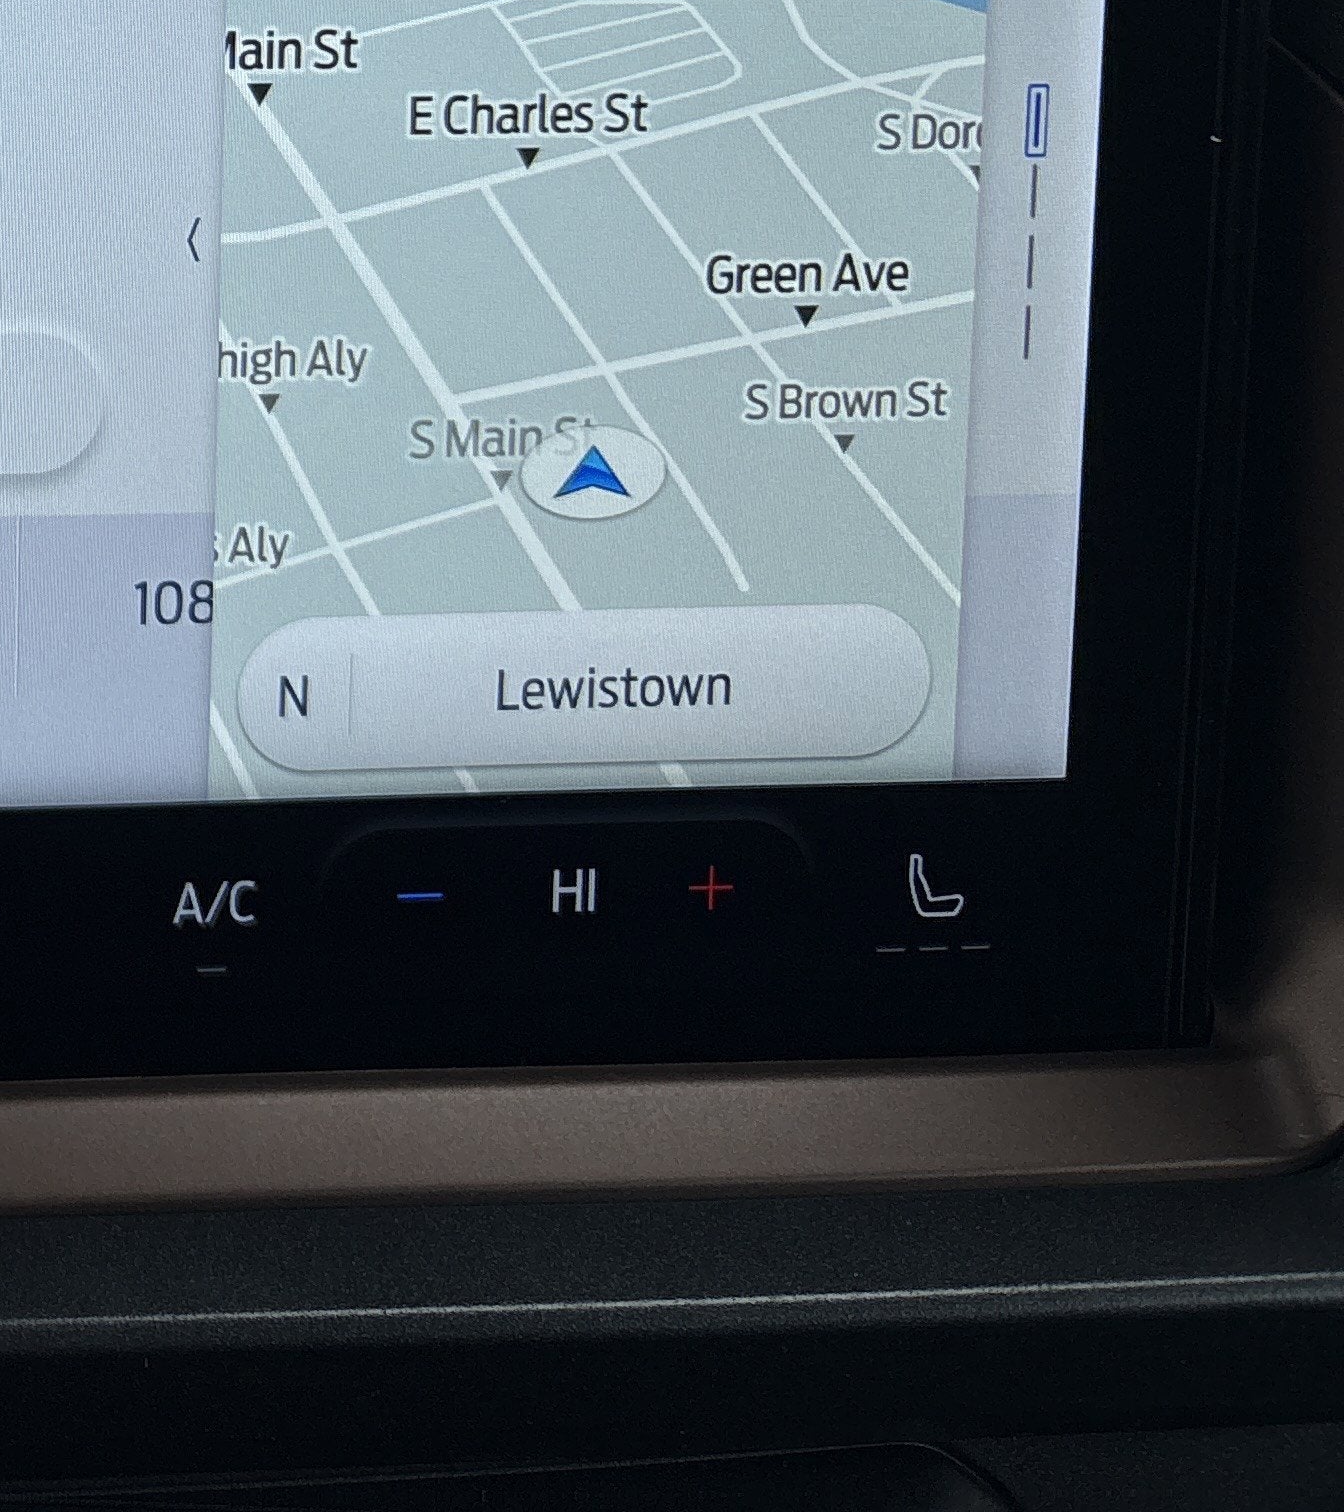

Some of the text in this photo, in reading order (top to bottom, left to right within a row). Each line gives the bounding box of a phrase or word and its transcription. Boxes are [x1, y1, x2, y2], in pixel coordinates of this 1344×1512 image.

[313, 29, 359, 70] St
[410, 92, 649, 136] E Charles St
[877, 113, 902, 151] S
[706, 252, 909, 295] Green Ave
[306, 338, 368, 383] Aly
[745, 380, 948, 421] S Brown St
[409, 419, 435, 460] S
[446, 417, 544, 459] Main
[228, 525, 289, 570] Aly
[279, 675, 309, 718] N
[497, 667, 731, 711] Lewistown
[172, 880, 255, 924] A/C
[552, 868, 596, 913] HI
